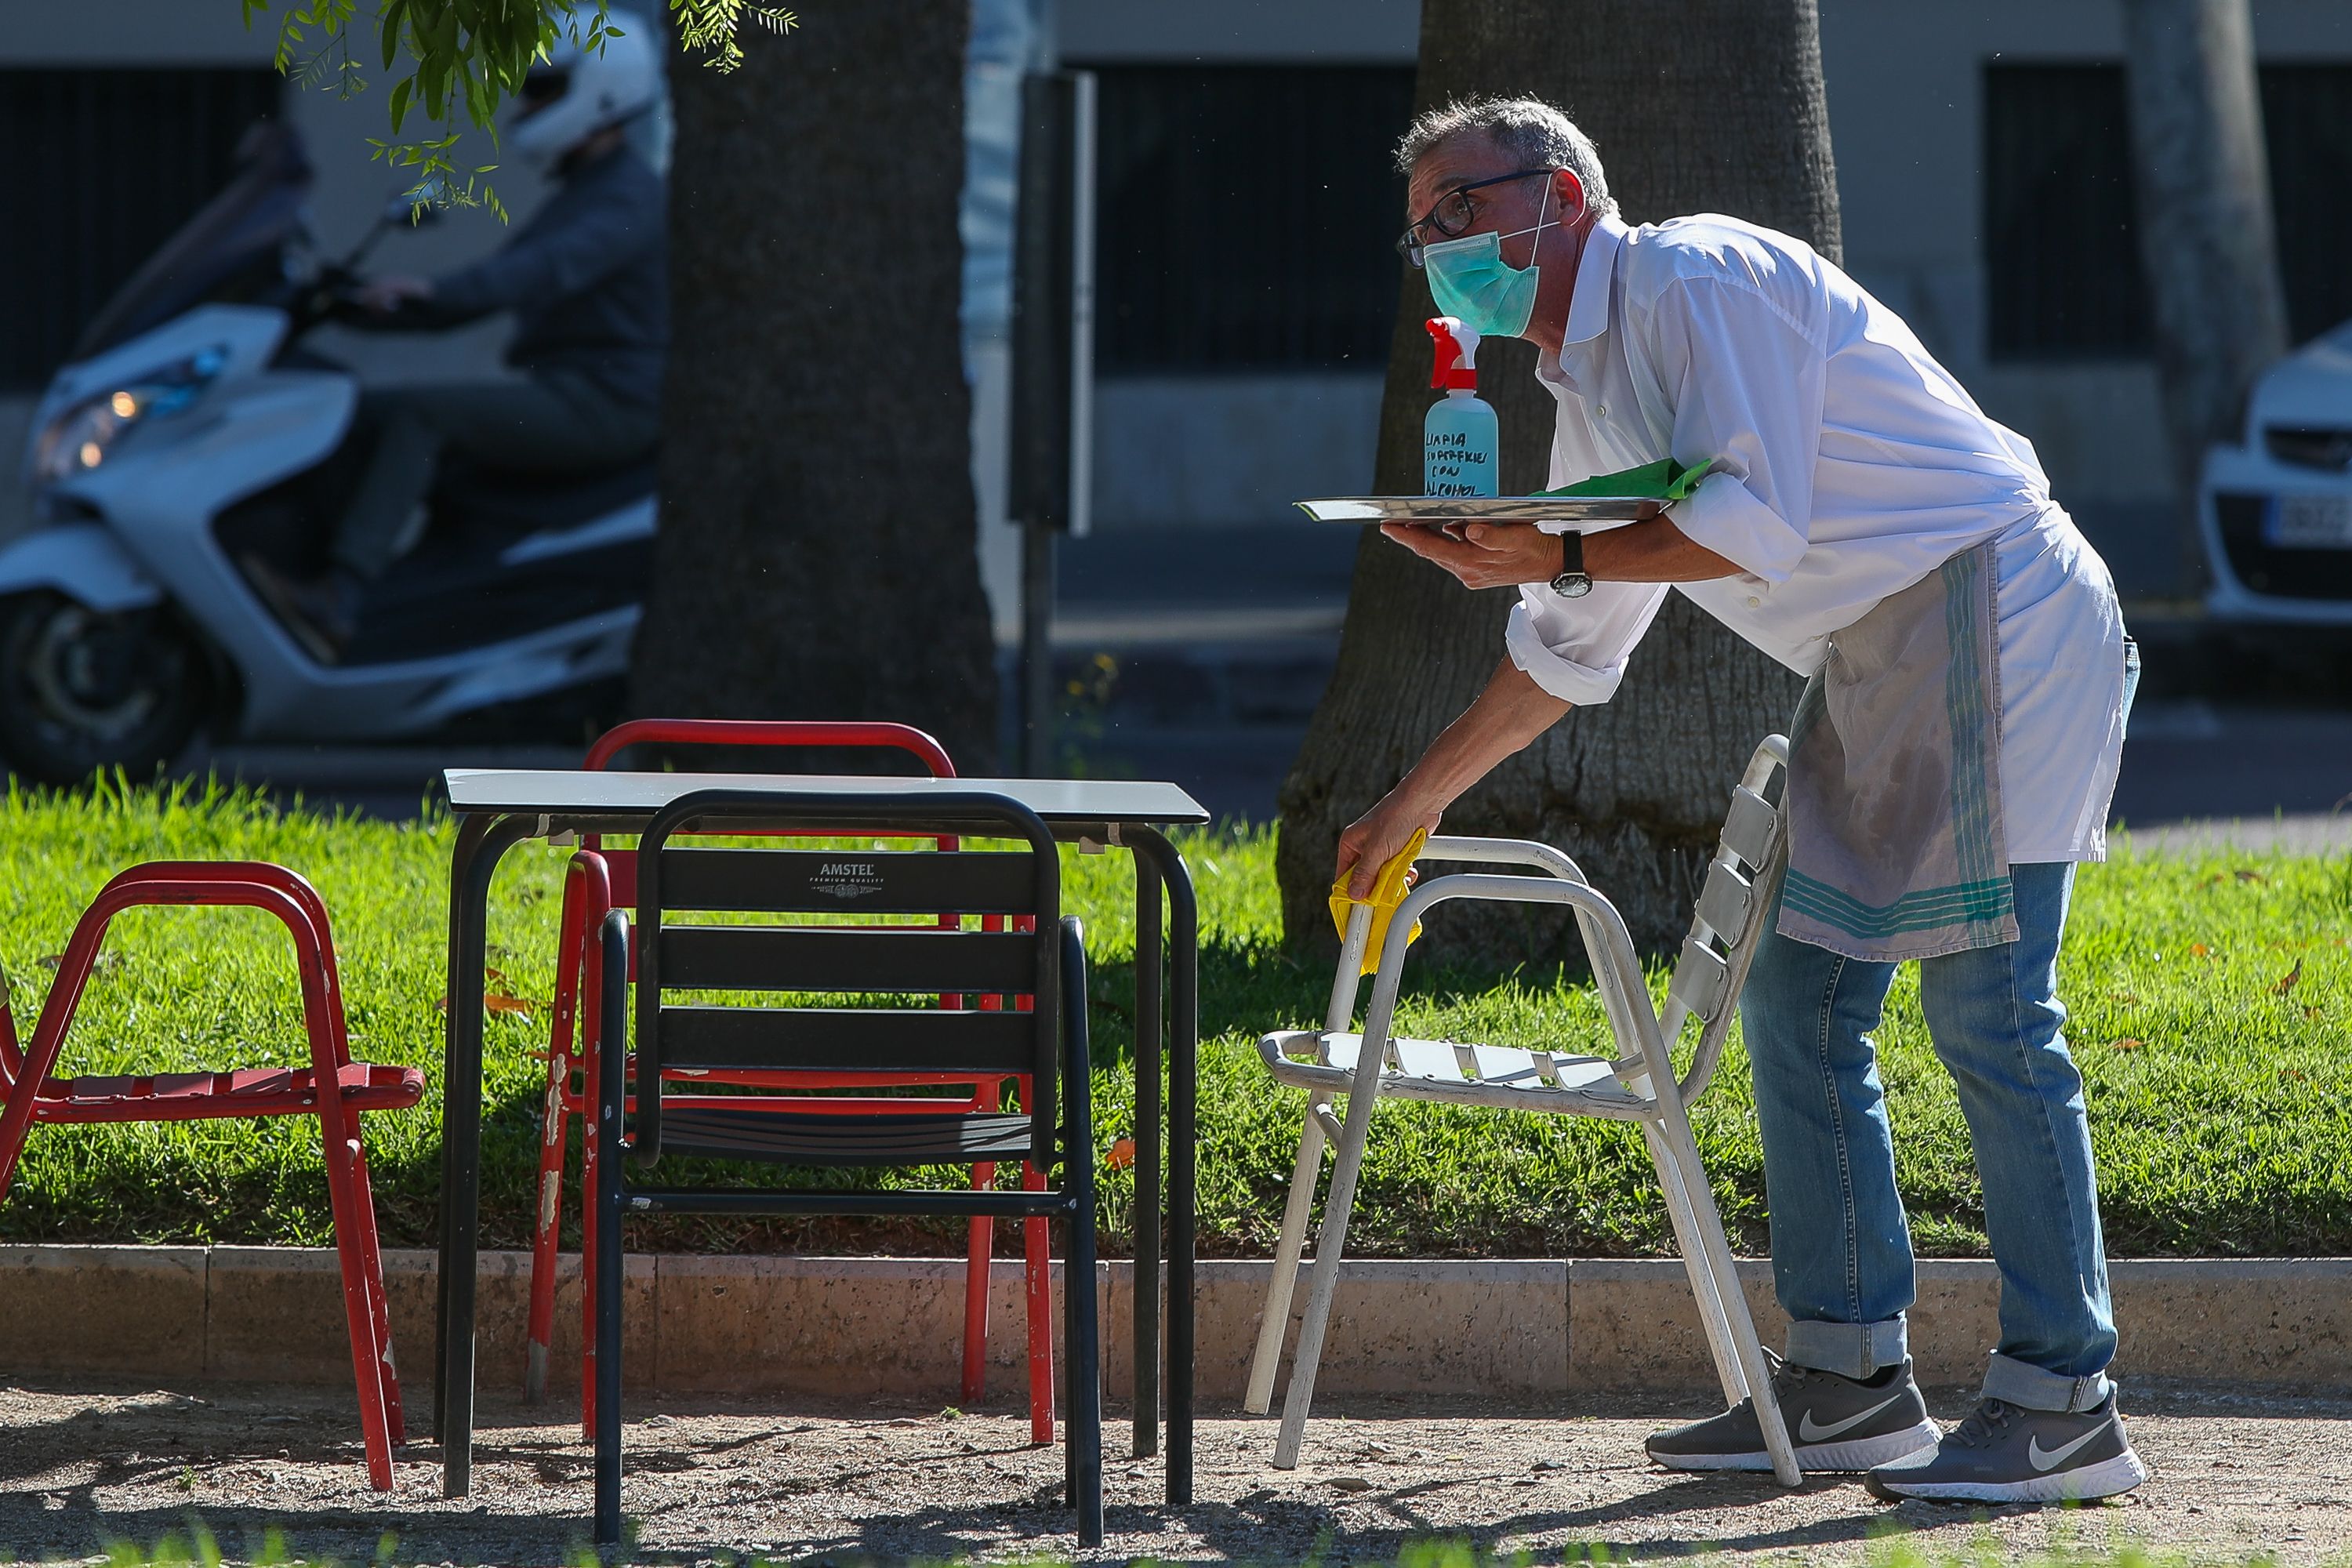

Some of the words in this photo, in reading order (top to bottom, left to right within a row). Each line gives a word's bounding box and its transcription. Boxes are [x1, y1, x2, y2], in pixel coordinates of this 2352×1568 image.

[1432, 465, 1460, 477] CON
[1426, 481, 1486, 497] ALCOHOL
[820, 863, 874, 876] AMSTEL
